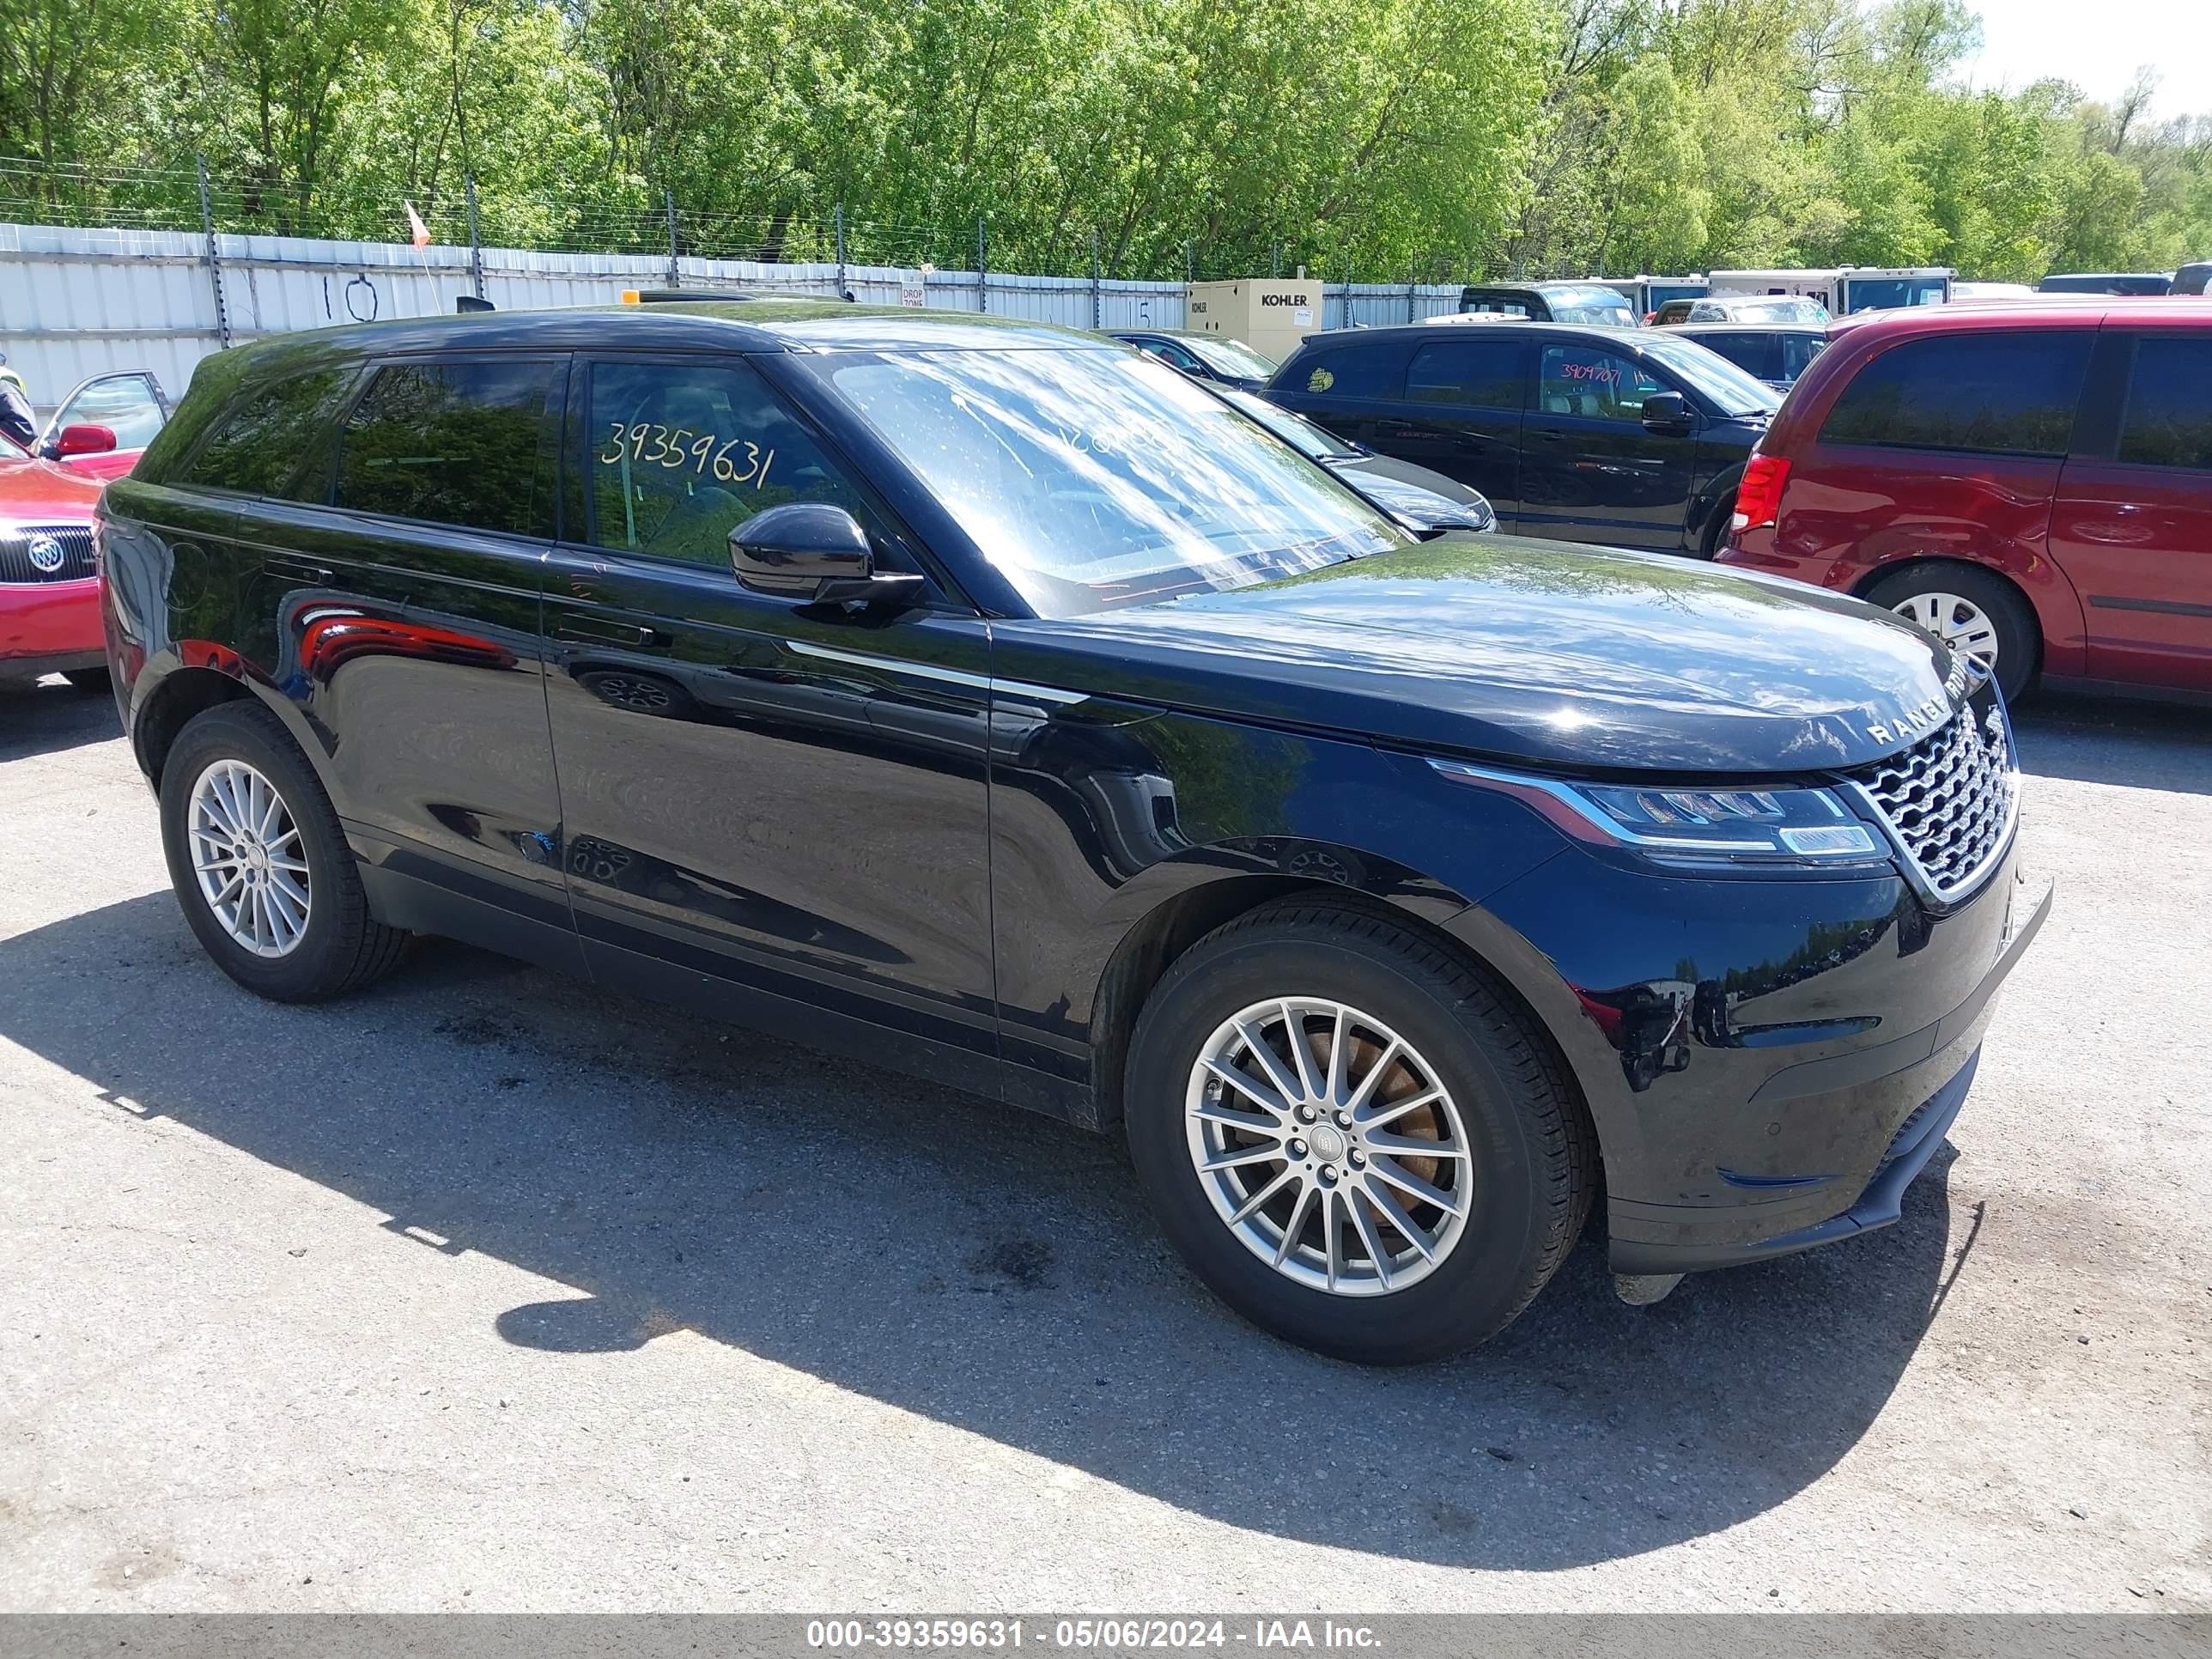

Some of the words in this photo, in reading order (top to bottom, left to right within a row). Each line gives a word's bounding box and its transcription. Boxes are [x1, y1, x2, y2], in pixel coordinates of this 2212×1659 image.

[323, 274, 379, 323] 10
[902, 289, 923, 299] DROP
[1261, 295, 1308, 307] KOHLER
[1191, 302, 1207, 313] KOHLER
[1561, 363, 1623, 387] 39097071
[601, 422, 775, 490] 39359631
[1866, 694, 1949, 745] RANGE
